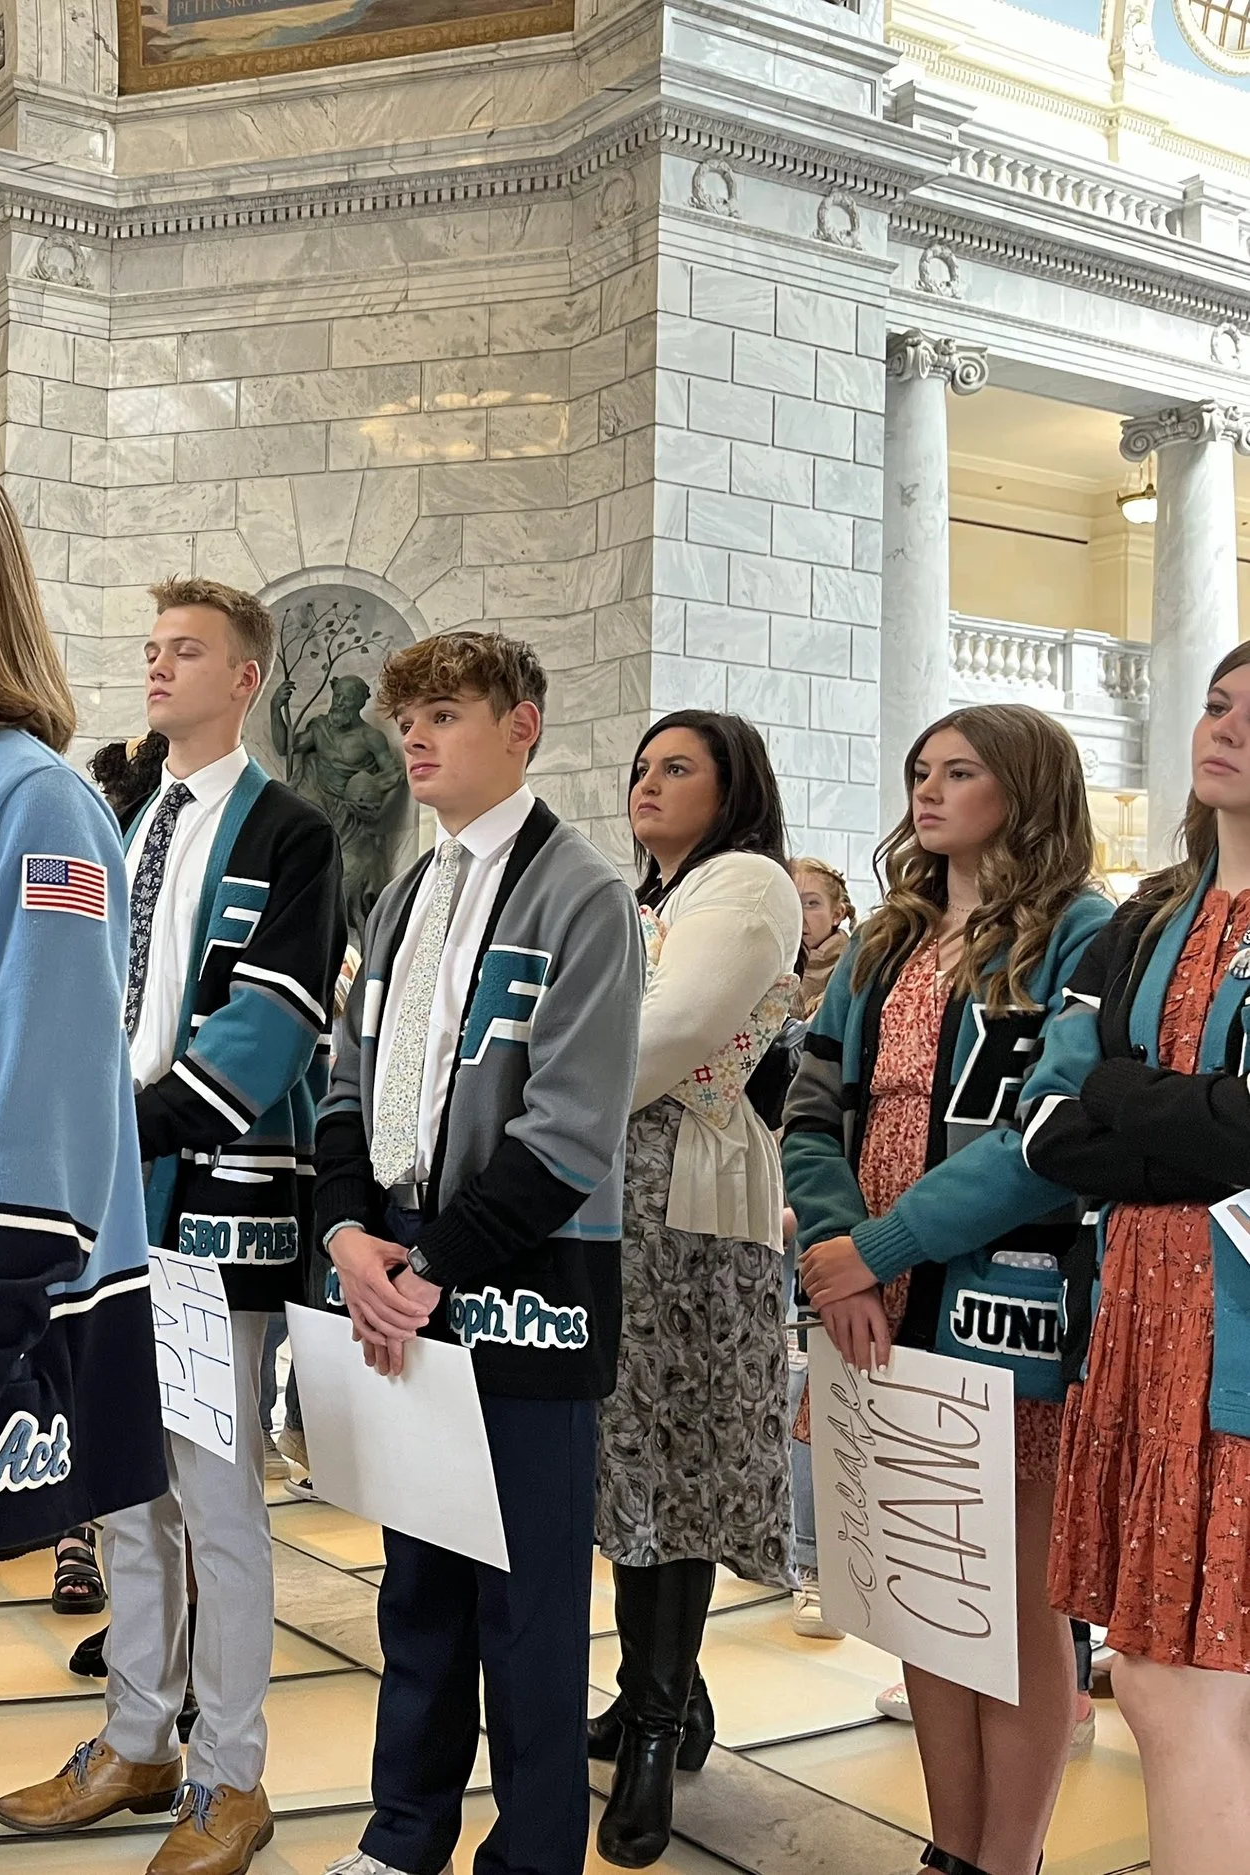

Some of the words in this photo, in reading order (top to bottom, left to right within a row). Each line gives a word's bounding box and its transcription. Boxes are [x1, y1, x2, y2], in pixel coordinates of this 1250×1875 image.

[180, 1217, 231, 1259] SBO
[236, 1221, 298, 1261] PRES
[166, 1257, 235, 1447] HELP
[953, 1296, 1058, 1354] JUNI
[866, 1372, 993, 1639] CHANGE
